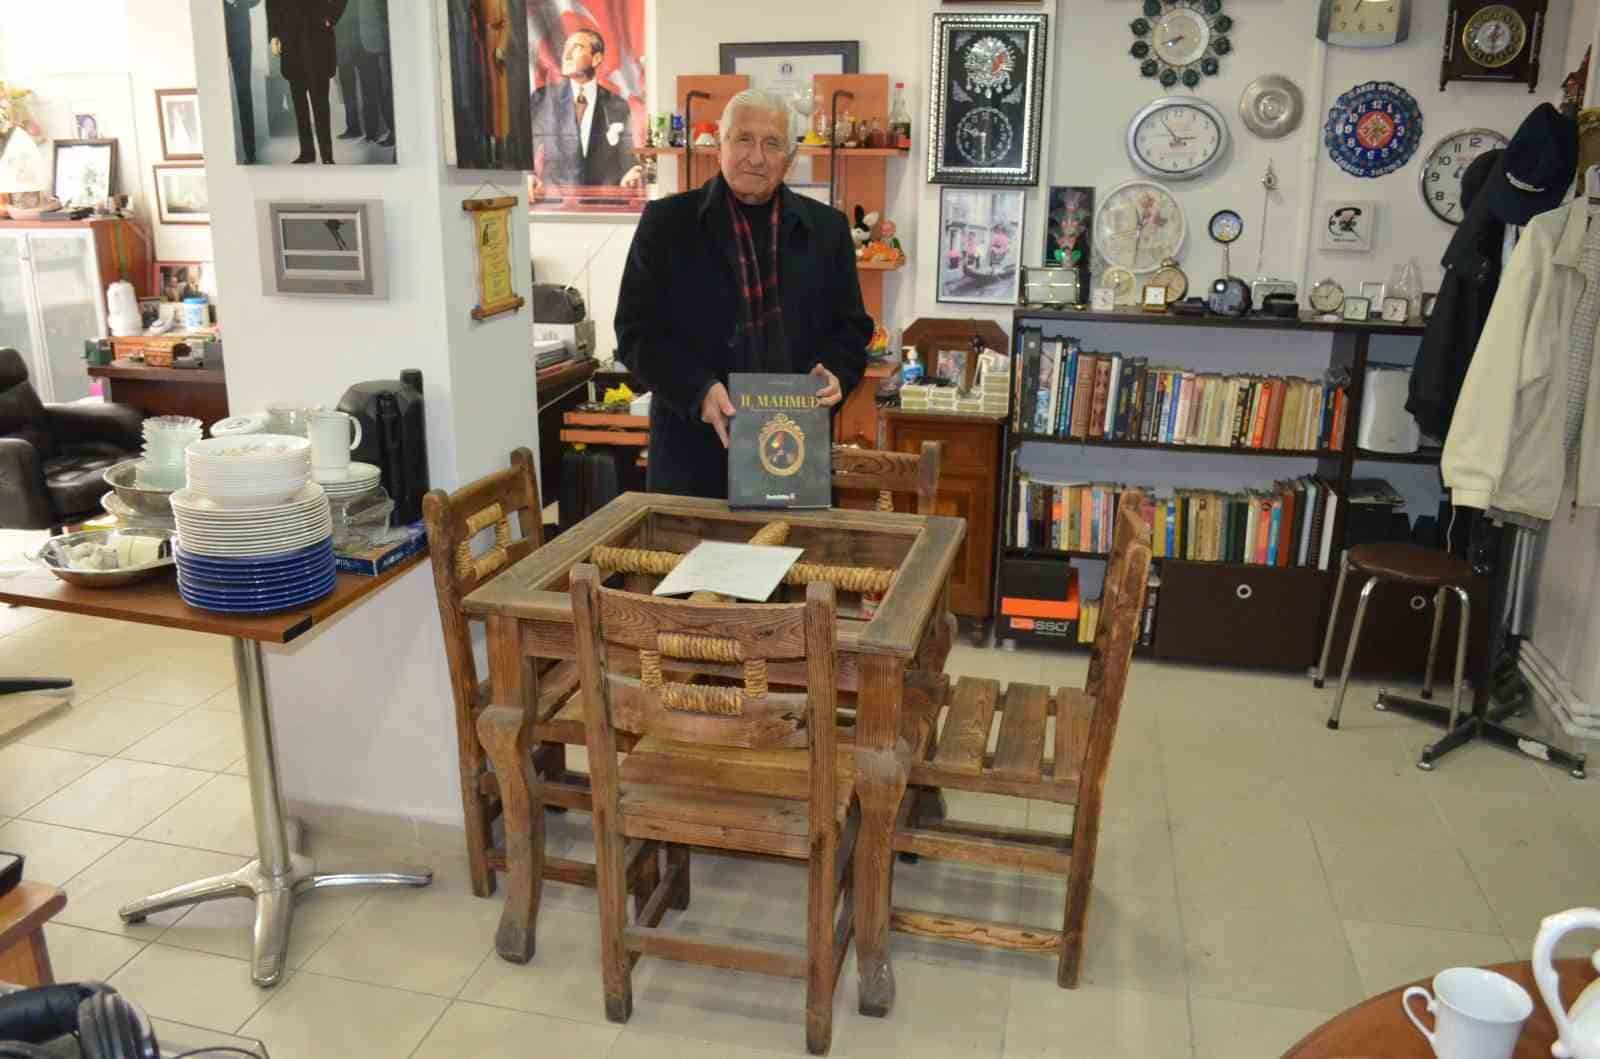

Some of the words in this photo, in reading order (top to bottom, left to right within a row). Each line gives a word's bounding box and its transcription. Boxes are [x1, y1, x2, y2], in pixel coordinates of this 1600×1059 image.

[1470, 136, 1482, 148] 12
[1454, 143, 1461, 153] 11
[1439, 155, 1451, 166] 10
[1431, 172, 1440, 182] 9
[1435, 191, 1445, 201] 8
[1448, 202, 1456, 213] 7
